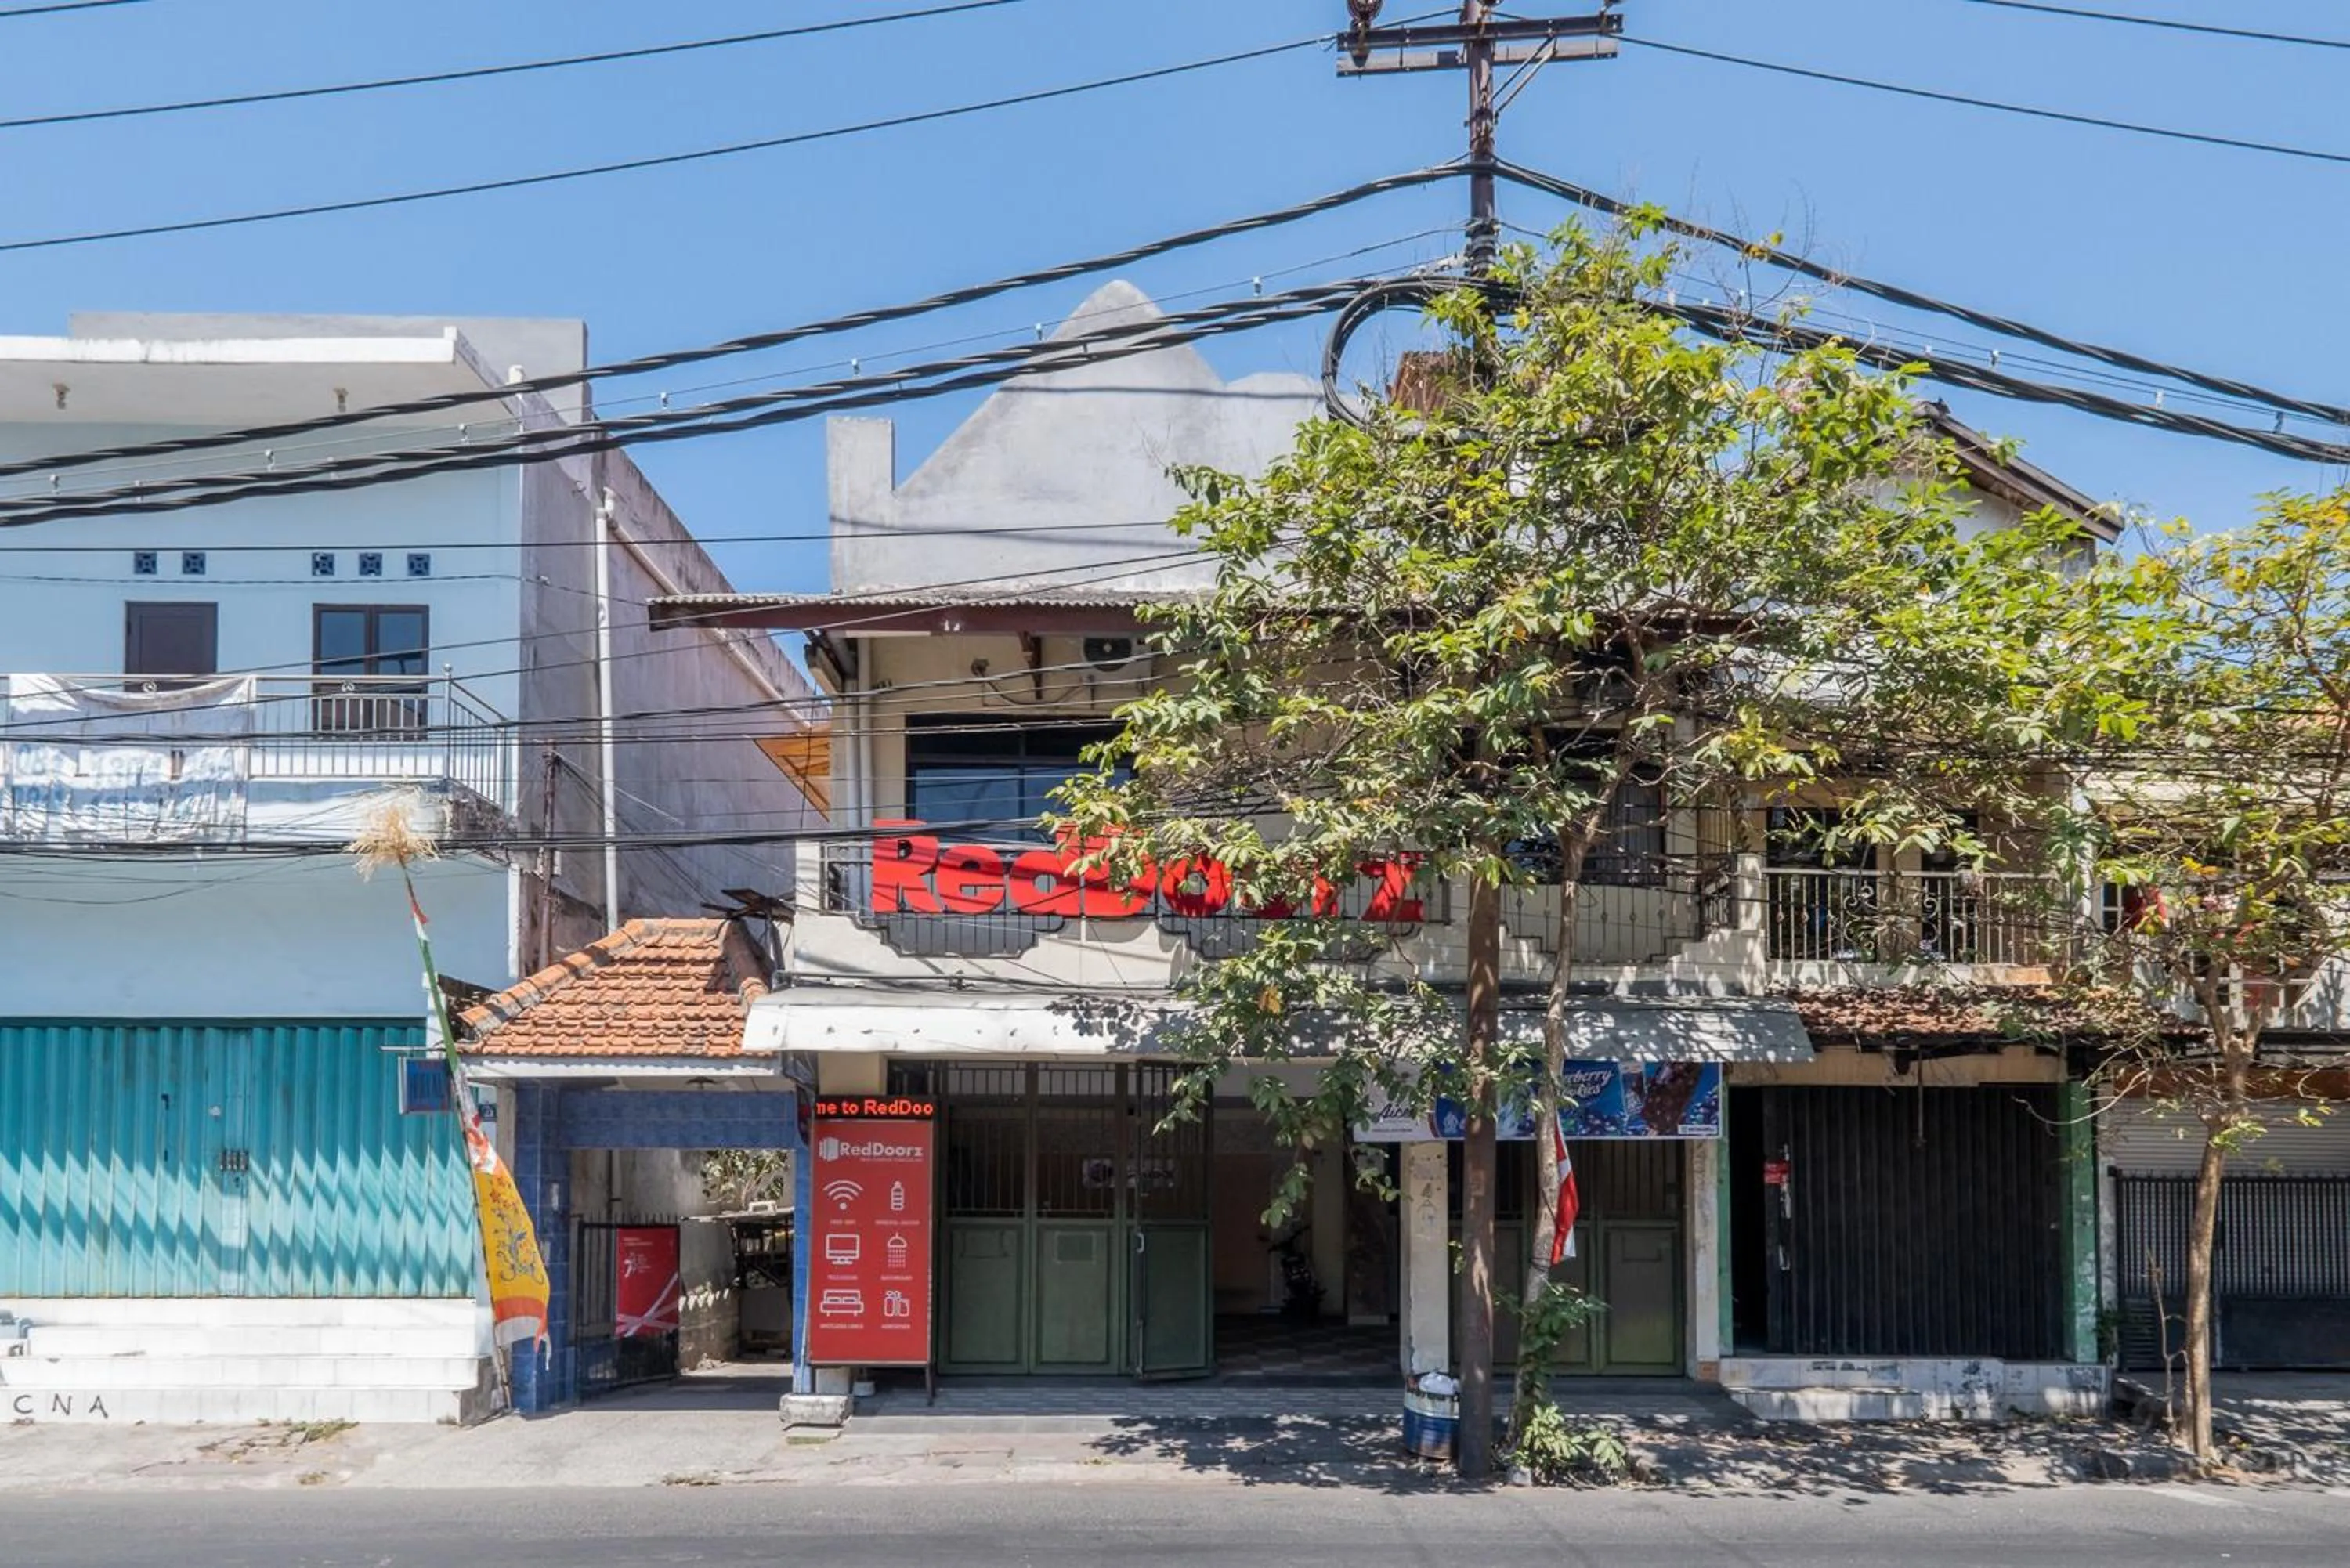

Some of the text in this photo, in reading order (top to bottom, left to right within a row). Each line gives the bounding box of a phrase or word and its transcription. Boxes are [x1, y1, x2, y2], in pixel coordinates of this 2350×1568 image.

[841, 1100, 859, 1115] to
[864, 1098, 934, 1115] RedDoo
[839, 1141, 924, 1157] RedDoorz
